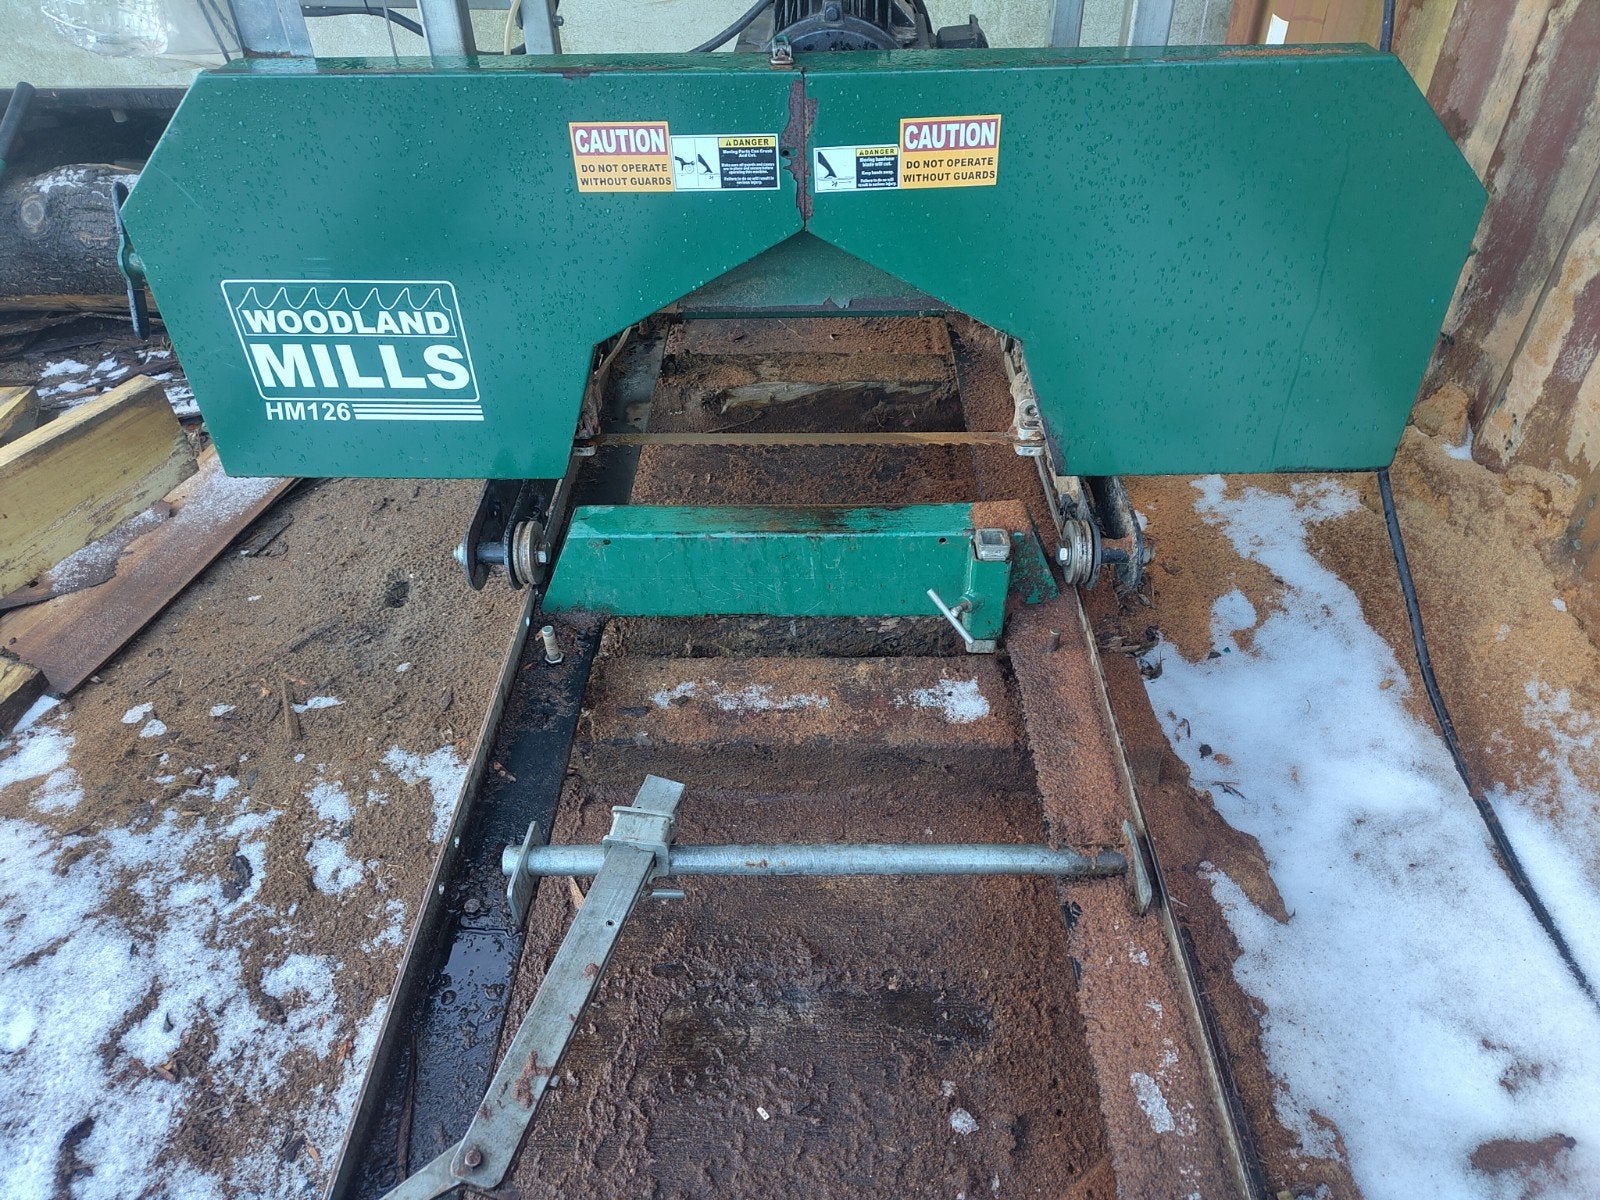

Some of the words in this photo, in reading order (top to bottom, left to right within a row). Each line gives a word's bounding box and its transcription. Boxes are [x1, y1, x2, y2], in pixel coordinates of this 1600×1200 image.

[575, 128, 666, 154] CAUTION
[733, 138, 769, 146] DANGER
[904, 122, 996, 149] CAUTION
[581, 164, 596, 173] DO
[598, 164, 619, 173] NOT
[621, 163, 668, 173] OPERATE
[906, 160, 920, 169] DO
[923, 159, 944, 169] NOT
[947, 157, 994, 168] OPERATE
[581, 177, 632, 186] WITHOUT
[635, 176, 672, 186] GUARDS
[903, 172, 951, 183] WITHOUT
[954, 170, 995, 181] GUARDS
[241, 309, 451, 335] WOODLAND
[249, 343, 470, 390] MILLS
[265, 401, 352, 421] HM126
